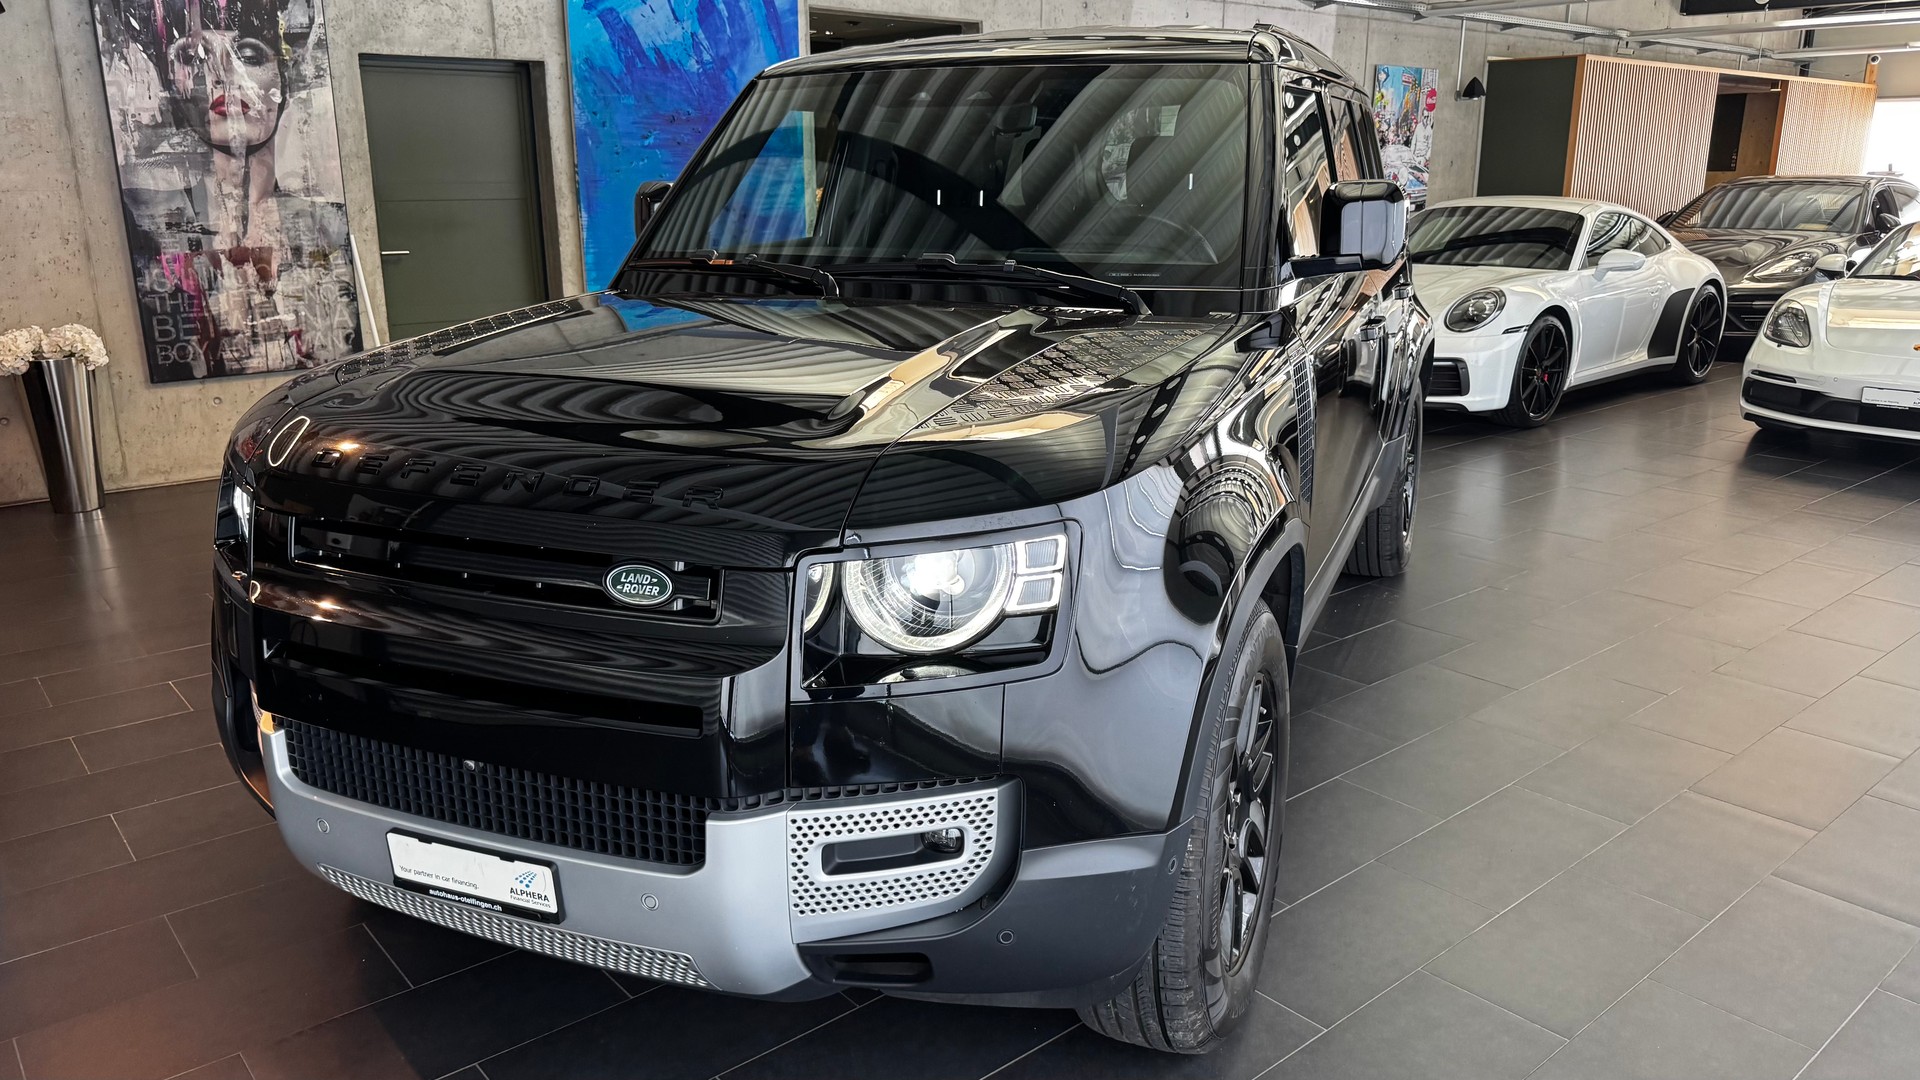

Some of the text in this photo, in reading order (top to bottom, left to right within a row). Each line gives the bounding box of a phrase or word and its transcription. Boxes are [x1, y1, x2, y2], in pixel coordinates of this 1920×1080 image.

[156, 342, 209, 366] BOY
[311, 446, 725, 511] DEFENDER
[509, 887, 550, 903] ALPHERA
